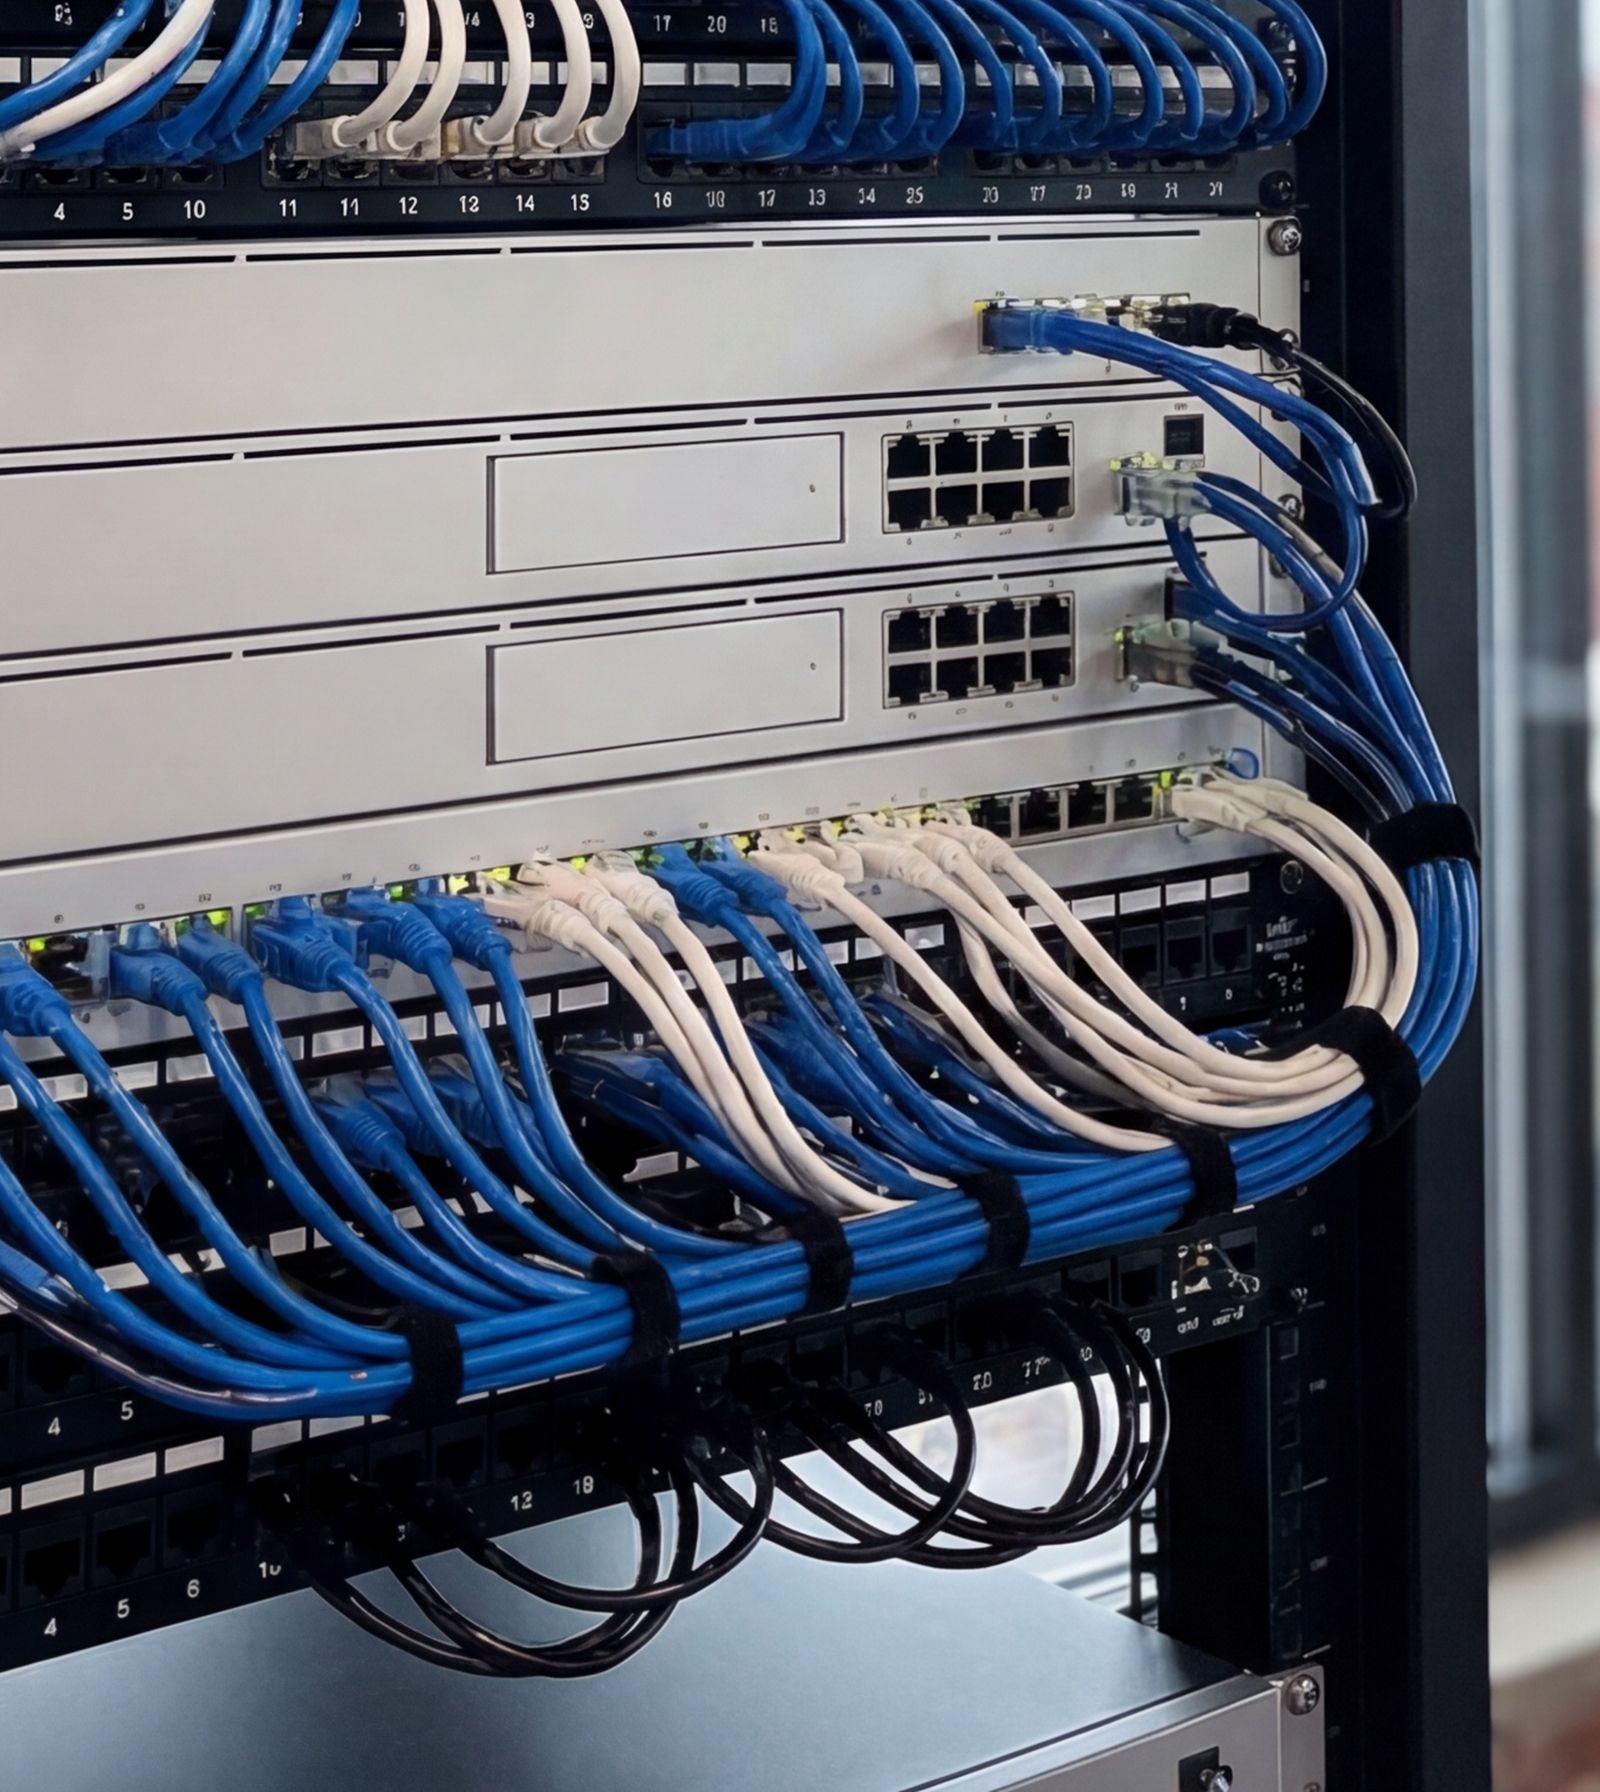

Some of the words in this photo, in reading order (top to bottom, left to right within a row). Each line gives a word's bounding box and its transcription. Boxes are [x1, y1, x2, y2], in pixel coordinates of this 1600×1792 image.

[53, 202, 66, 221] 4
[122, 202, 134, 221] 5
[183, 199, 206, 219] 10
[279, 198, 297, 217] 11
[399, 196, 418, 215] 12
[515, 194, 535, 212] 14
[47, 1417, 61, 1436] 4
[120, 1400, 134, 1421] 5
[43, 1617, 57, 1636] 4
[117, 1598, 130, 1619] 5
[186, 1578, 200, 1599] 6
[510, 1490, 533, 1511] 12
[574, 1475, 594, 1495] 18
